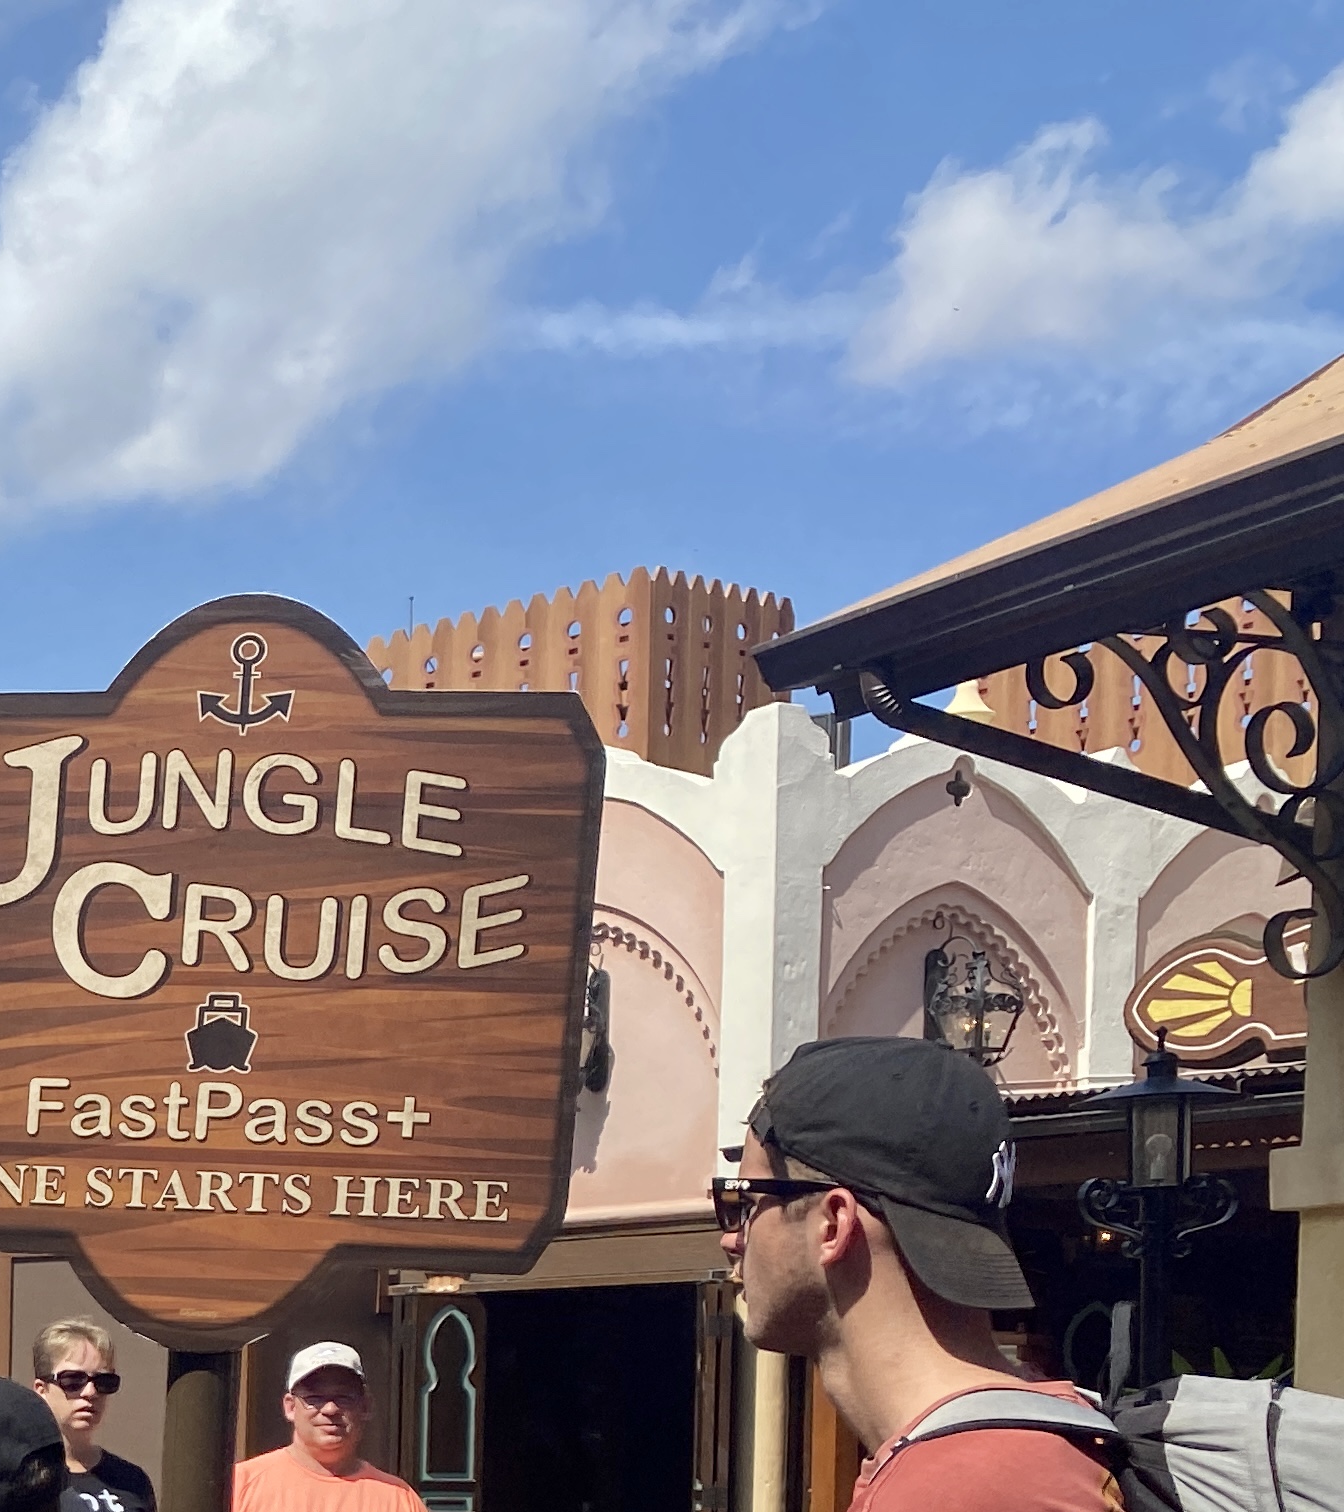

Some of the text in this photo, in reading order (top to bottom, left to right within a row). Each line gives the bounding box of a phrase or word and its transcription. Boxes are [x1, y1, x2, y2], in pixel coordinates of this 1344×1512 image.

[52, 861, 531, 1000] CRUISE
[25, 1077, 431, 1147] FastPass+
[84, 1166, 312, 1216] STARTS
[331, 1175, 510, 1223] HERE
